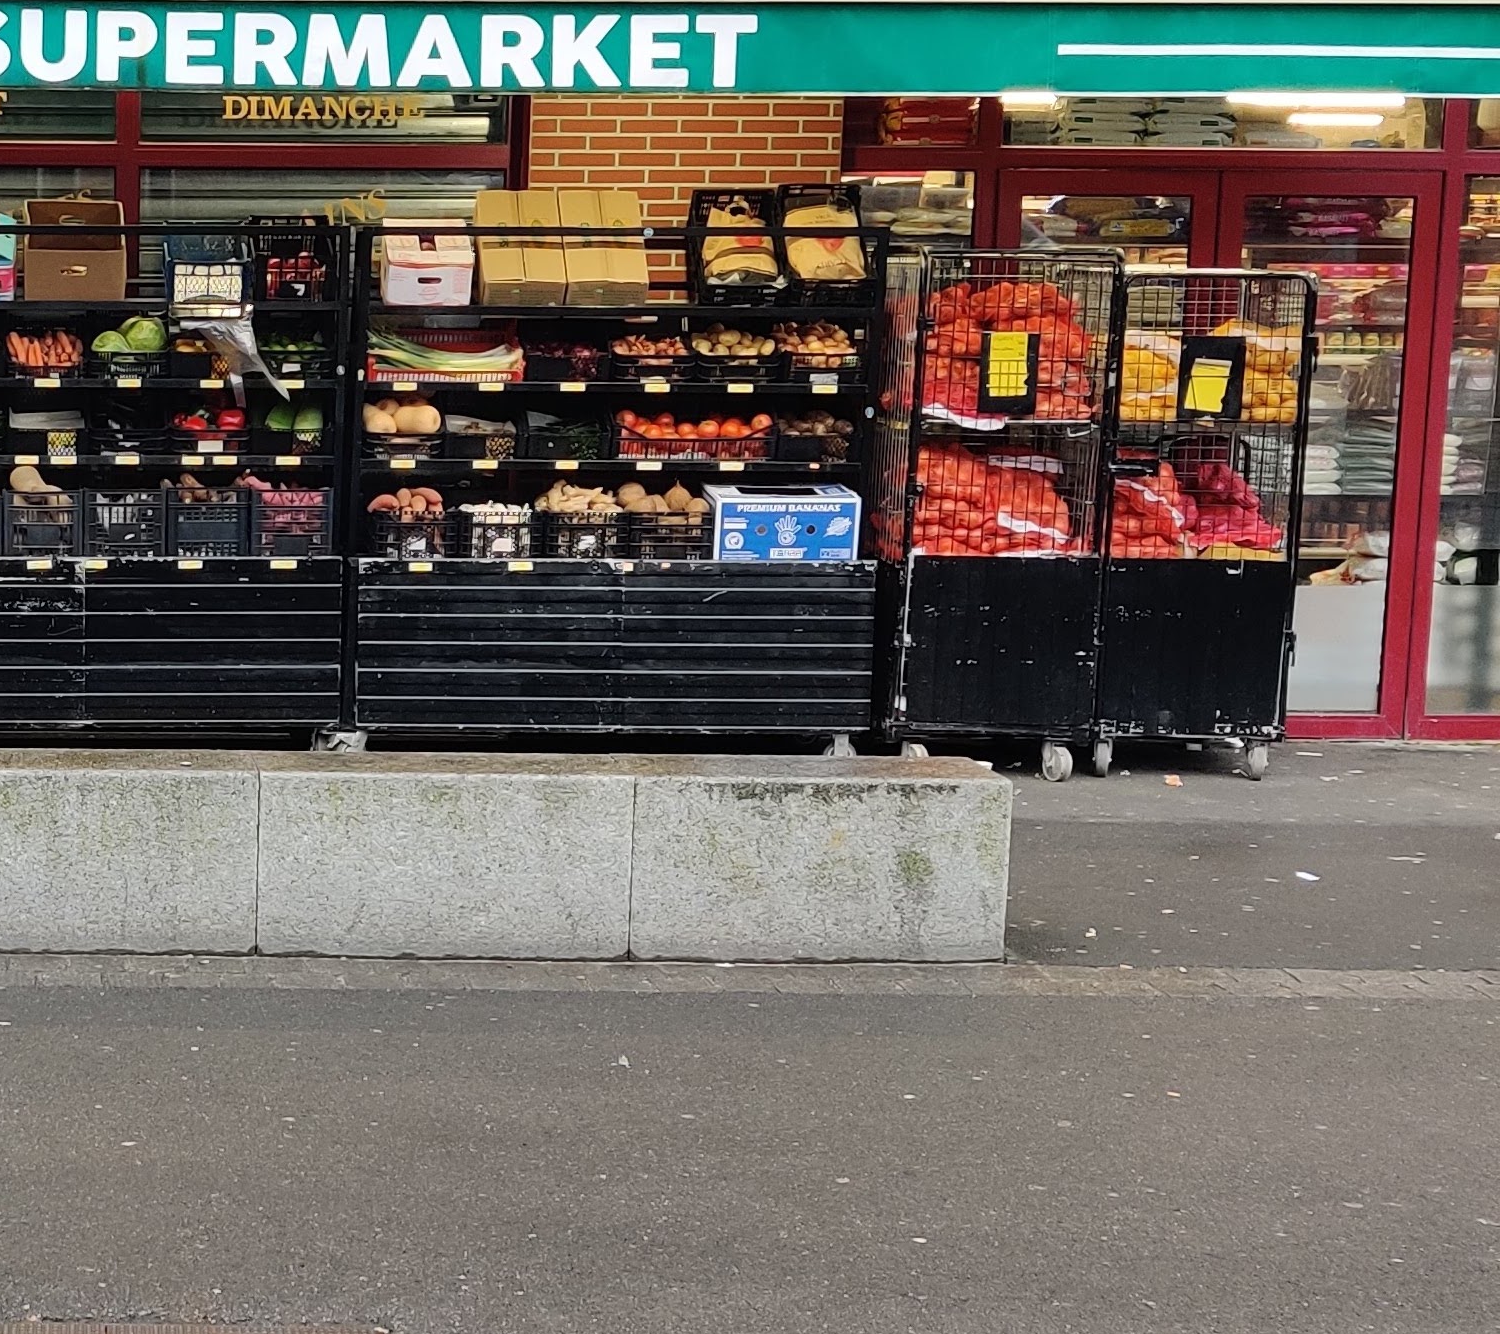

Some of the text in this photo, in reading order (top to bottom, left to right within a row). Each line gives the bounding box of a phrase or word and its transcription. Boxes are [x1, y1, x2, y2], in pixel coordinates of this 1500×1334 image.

[222, 94, 425, 120] DIMANCHE
[736, 504, 841, 513] PREMIUM BANANAS
